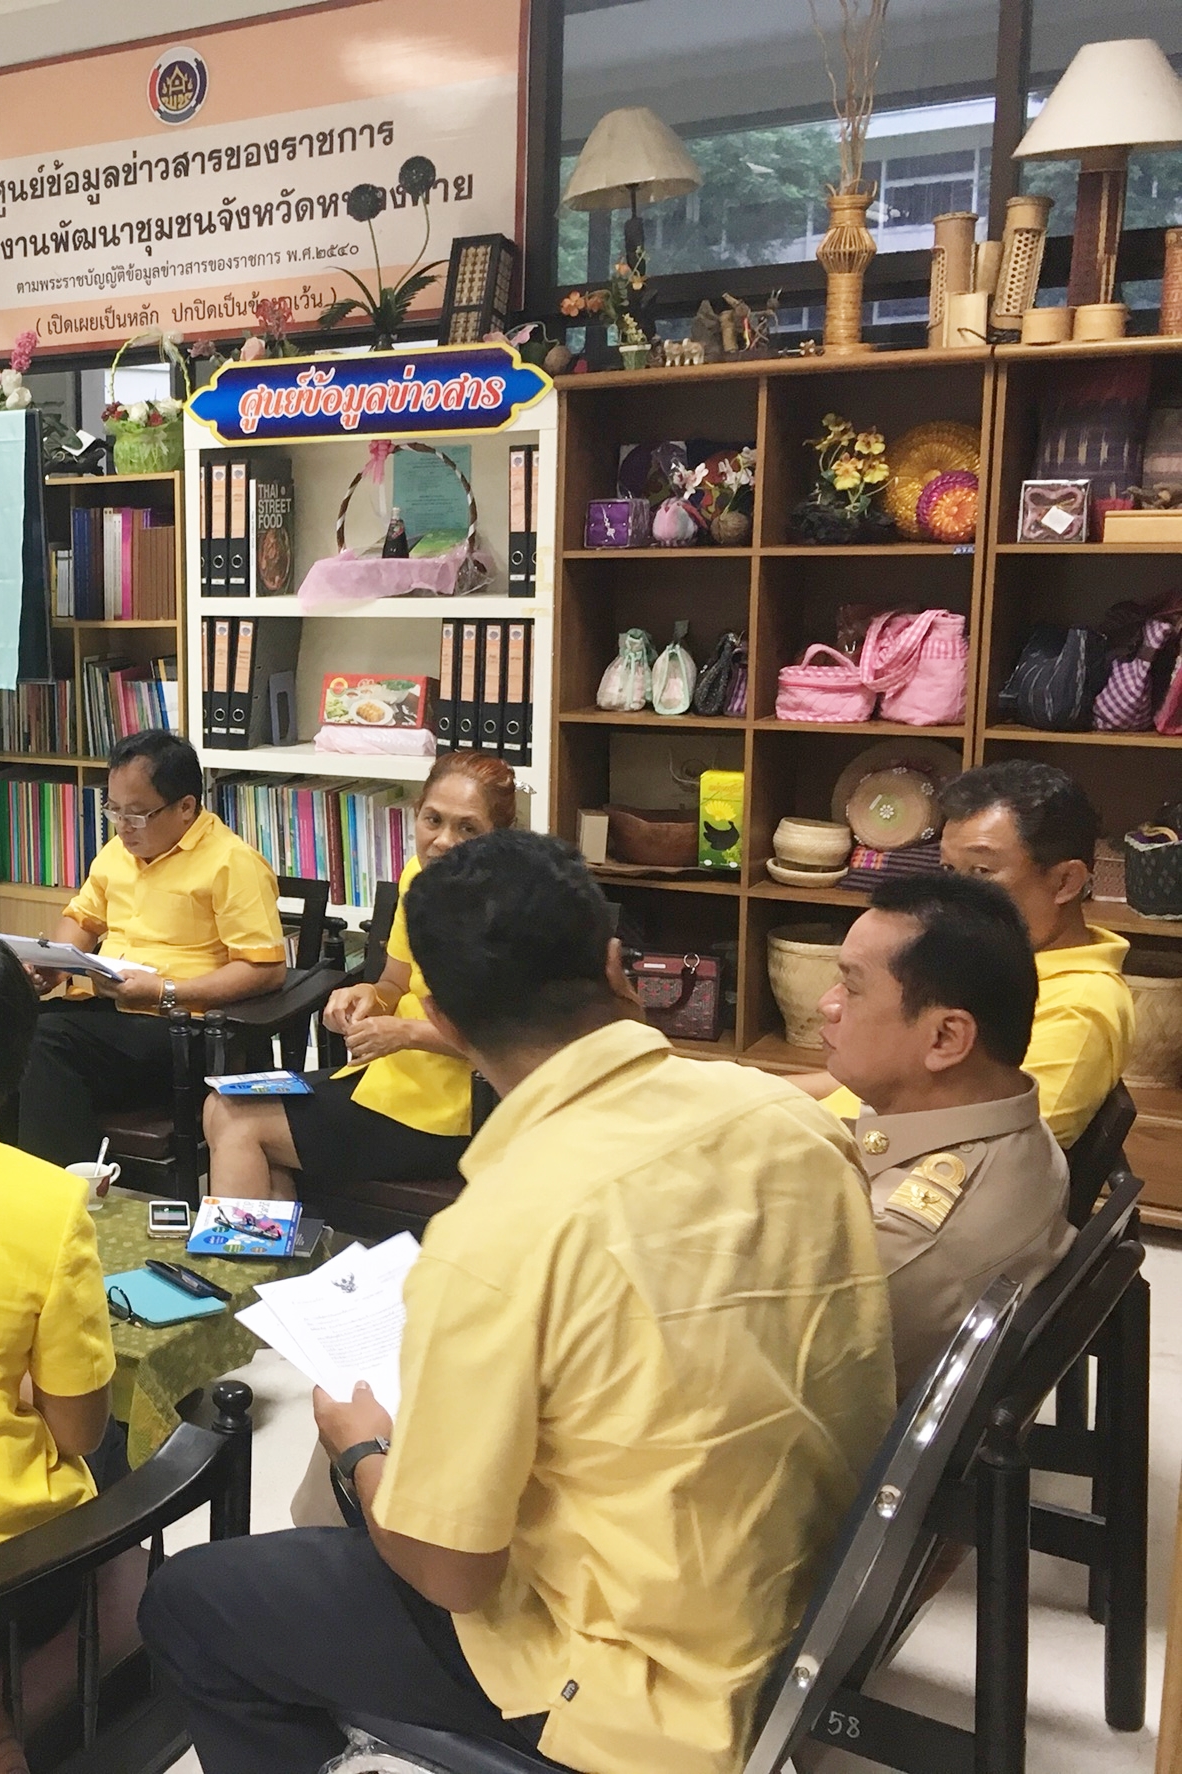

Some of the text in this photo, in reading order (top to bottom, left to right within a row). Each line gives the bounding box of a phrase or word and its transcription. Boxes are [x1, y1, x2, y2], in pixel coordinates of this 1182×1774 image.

[286, 241, 360, 265] พ.ศ.๒๕๔๐
[239, 365, 506, 434] ศูนย์ข้อมูลข่าวสาร
[258, 484, 278, 499] THAI
[258, 499, 291, 514] STREET
[258, 514, 283, 529] FOOD
